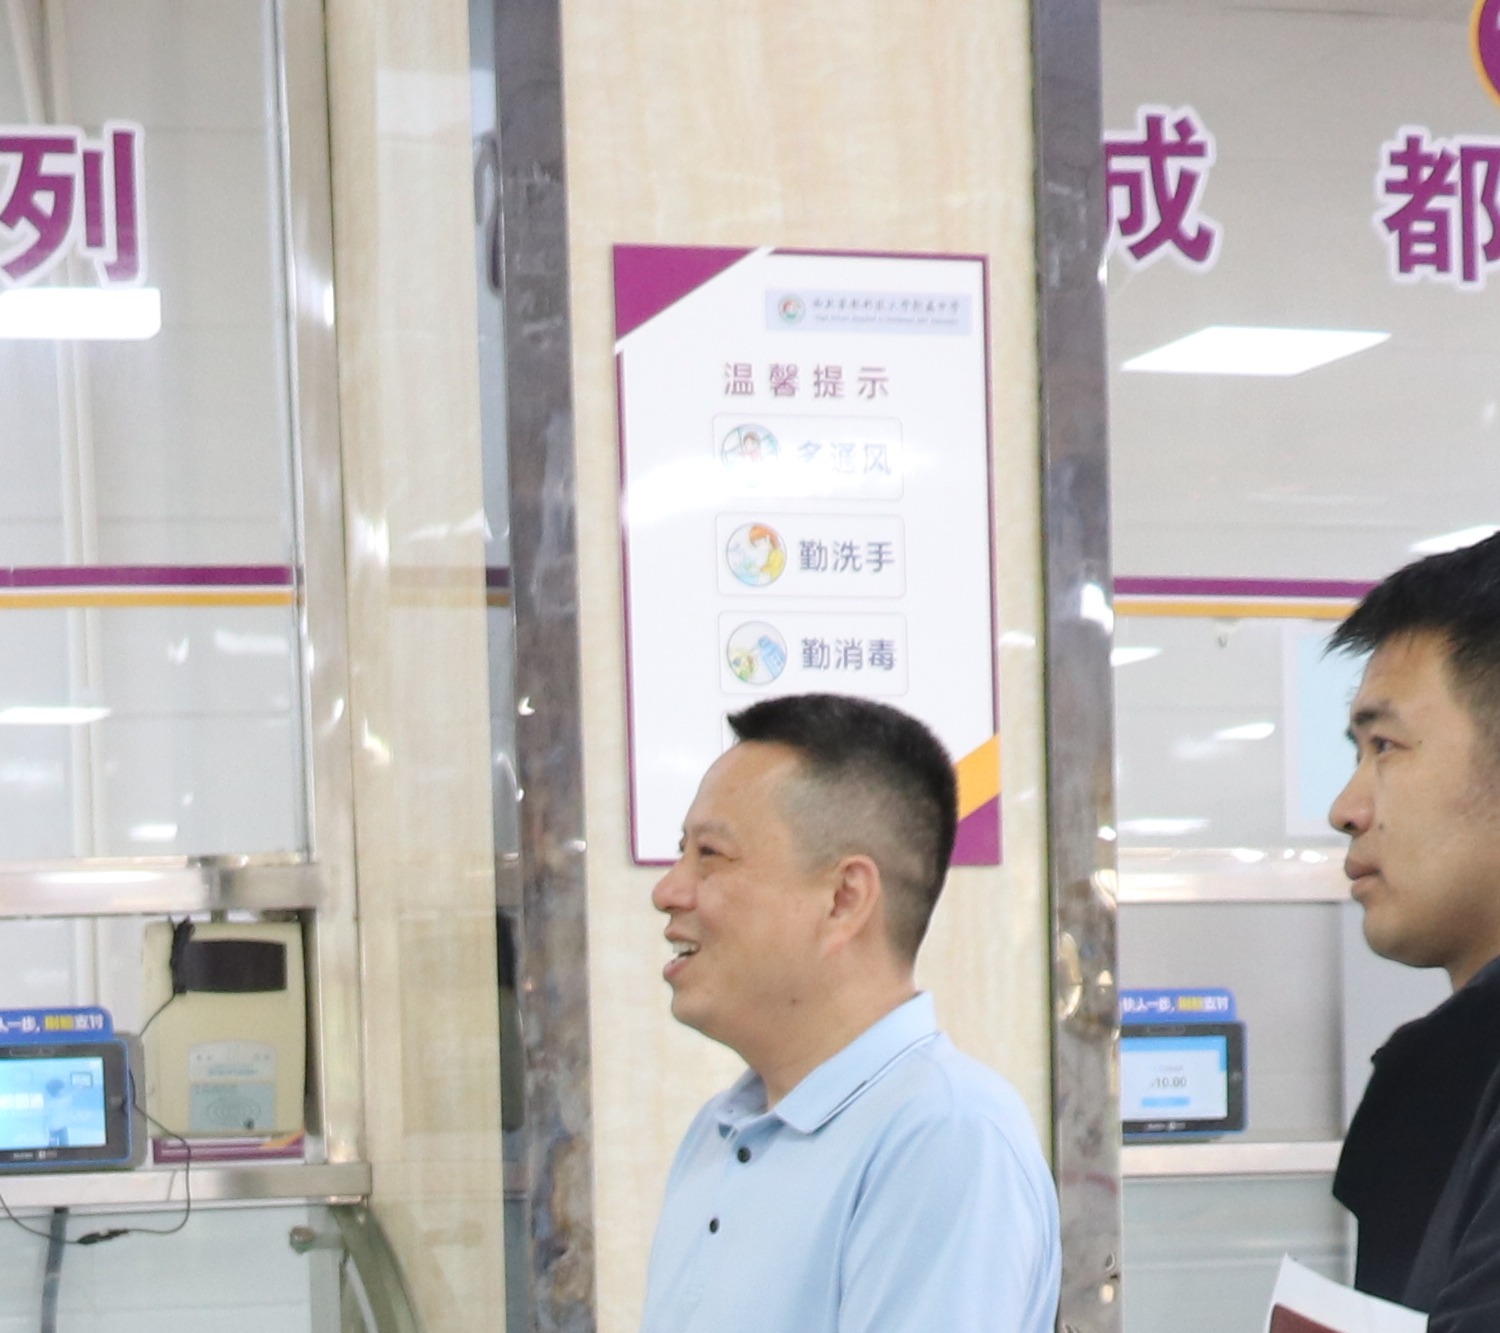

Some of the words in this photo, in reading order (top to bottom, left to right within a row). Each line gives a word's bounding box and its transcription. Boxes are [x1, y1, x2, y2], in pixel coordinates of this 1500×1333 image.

[723, 362, 891, 400] 温馨提示
[798, 539, 896, 574] 勤洗手
[800, 637, 897, 672] 勤消毒
